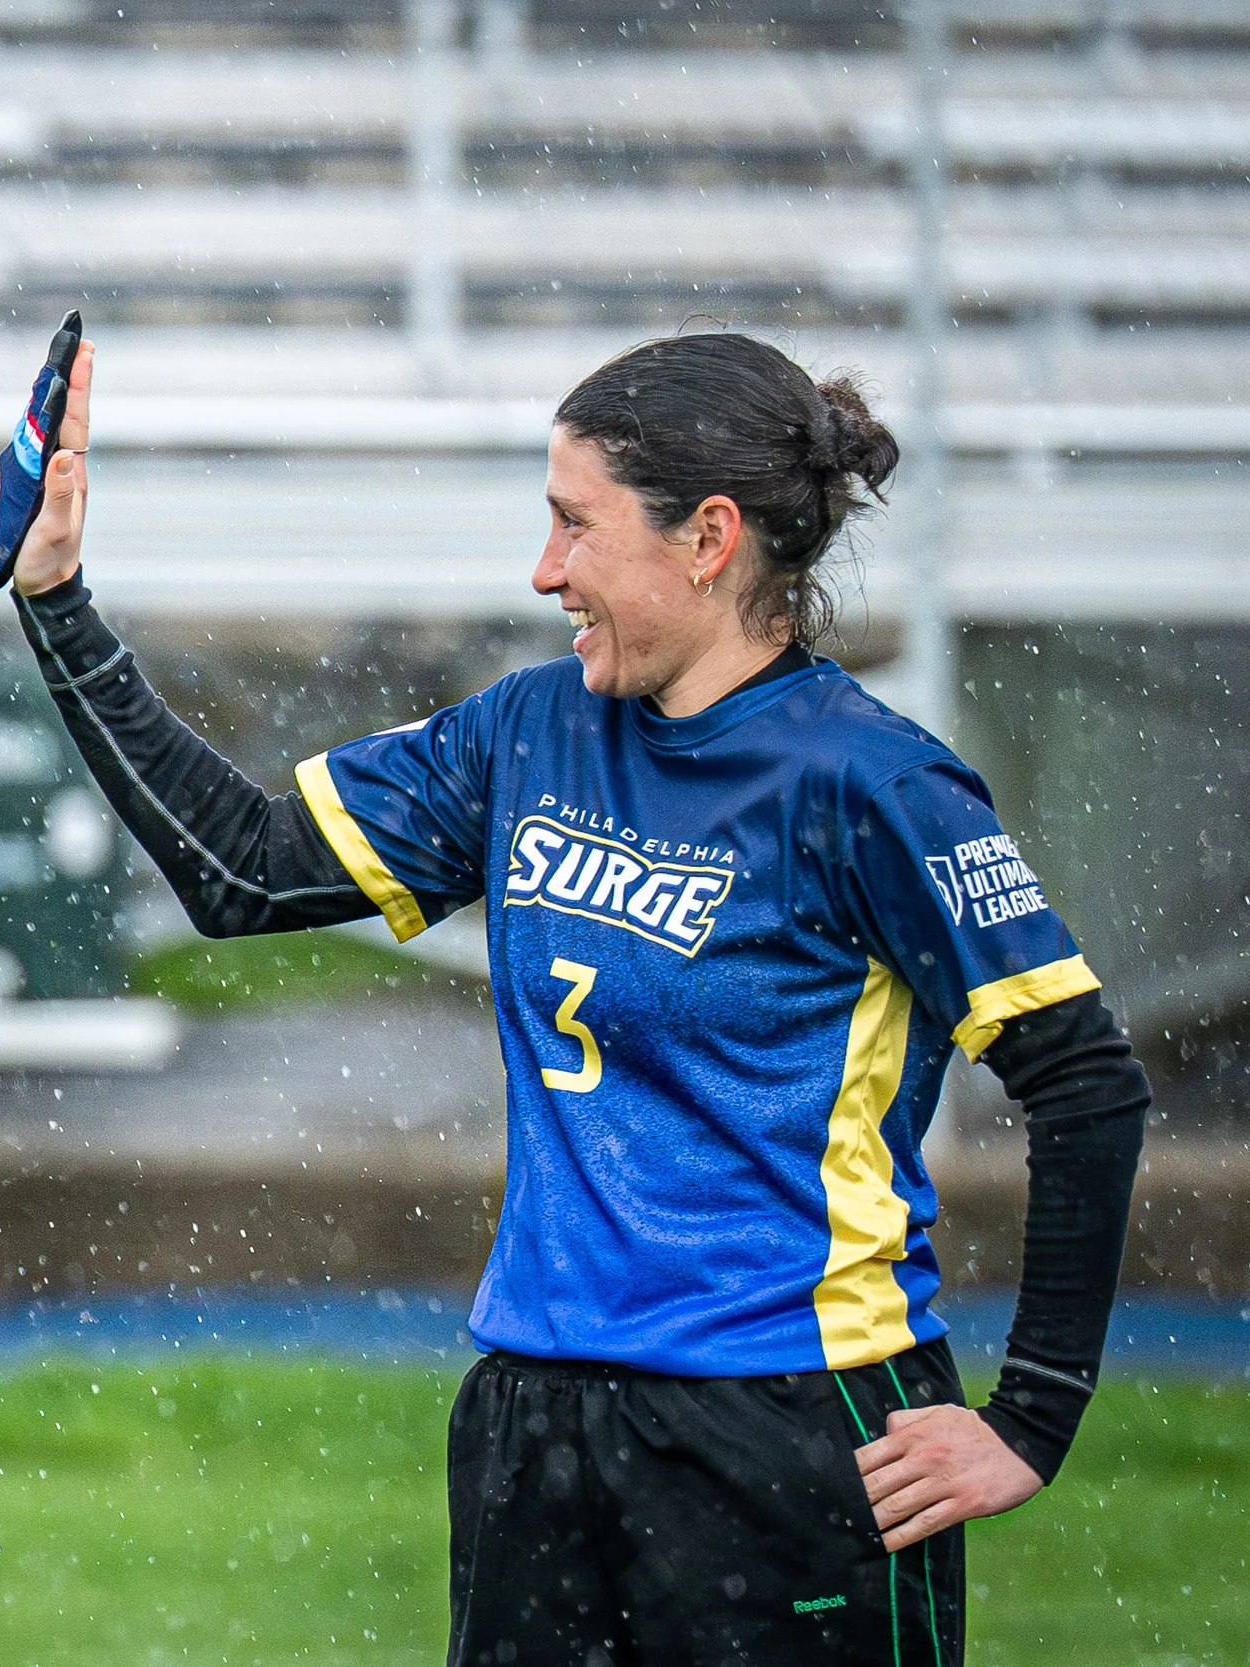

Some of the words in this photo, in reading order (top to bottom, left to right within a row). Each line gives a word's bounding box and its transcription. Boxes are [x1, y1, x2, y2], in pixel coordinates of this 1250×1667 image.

[538, 793, 735, 865] PHILADELPHIA
[506, 825, 723, 943] SURGE
[971, 885, 1050, 929] LEAGUE
[540, 956, 603, 1094] 3
[792, 1593, 847, 1615] Reebok
